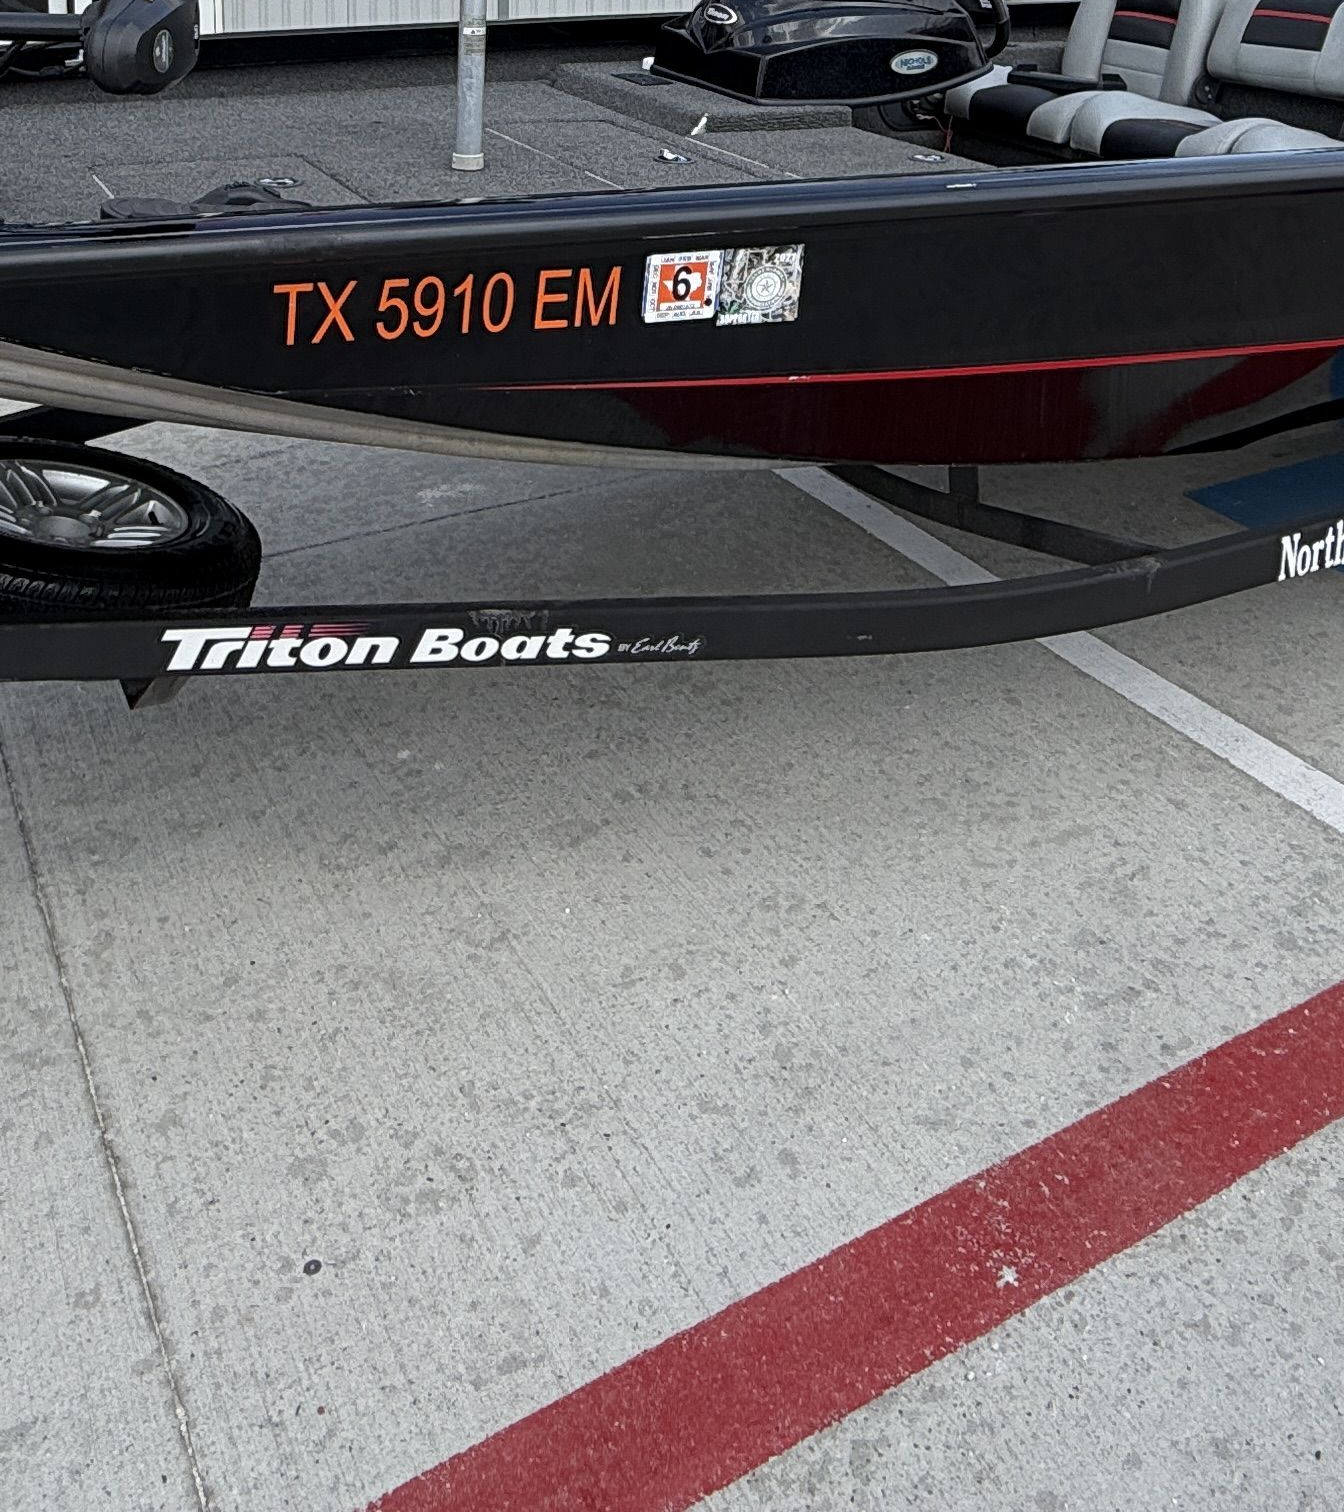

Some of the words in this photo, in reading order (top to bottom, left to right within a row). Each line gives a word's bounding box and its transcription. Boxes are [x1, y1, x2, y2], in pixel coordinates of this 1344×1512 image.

[273, 280, 358, 346] TX
[376, 271, 515, 340] 5910
[534, 266, 622, 330] EM
[672, 265, 692, 301] 6
[159, 624, 400, 672] Triton
[409, 627, 613, 664] Boats
[617, 642, 632, 652] BY
